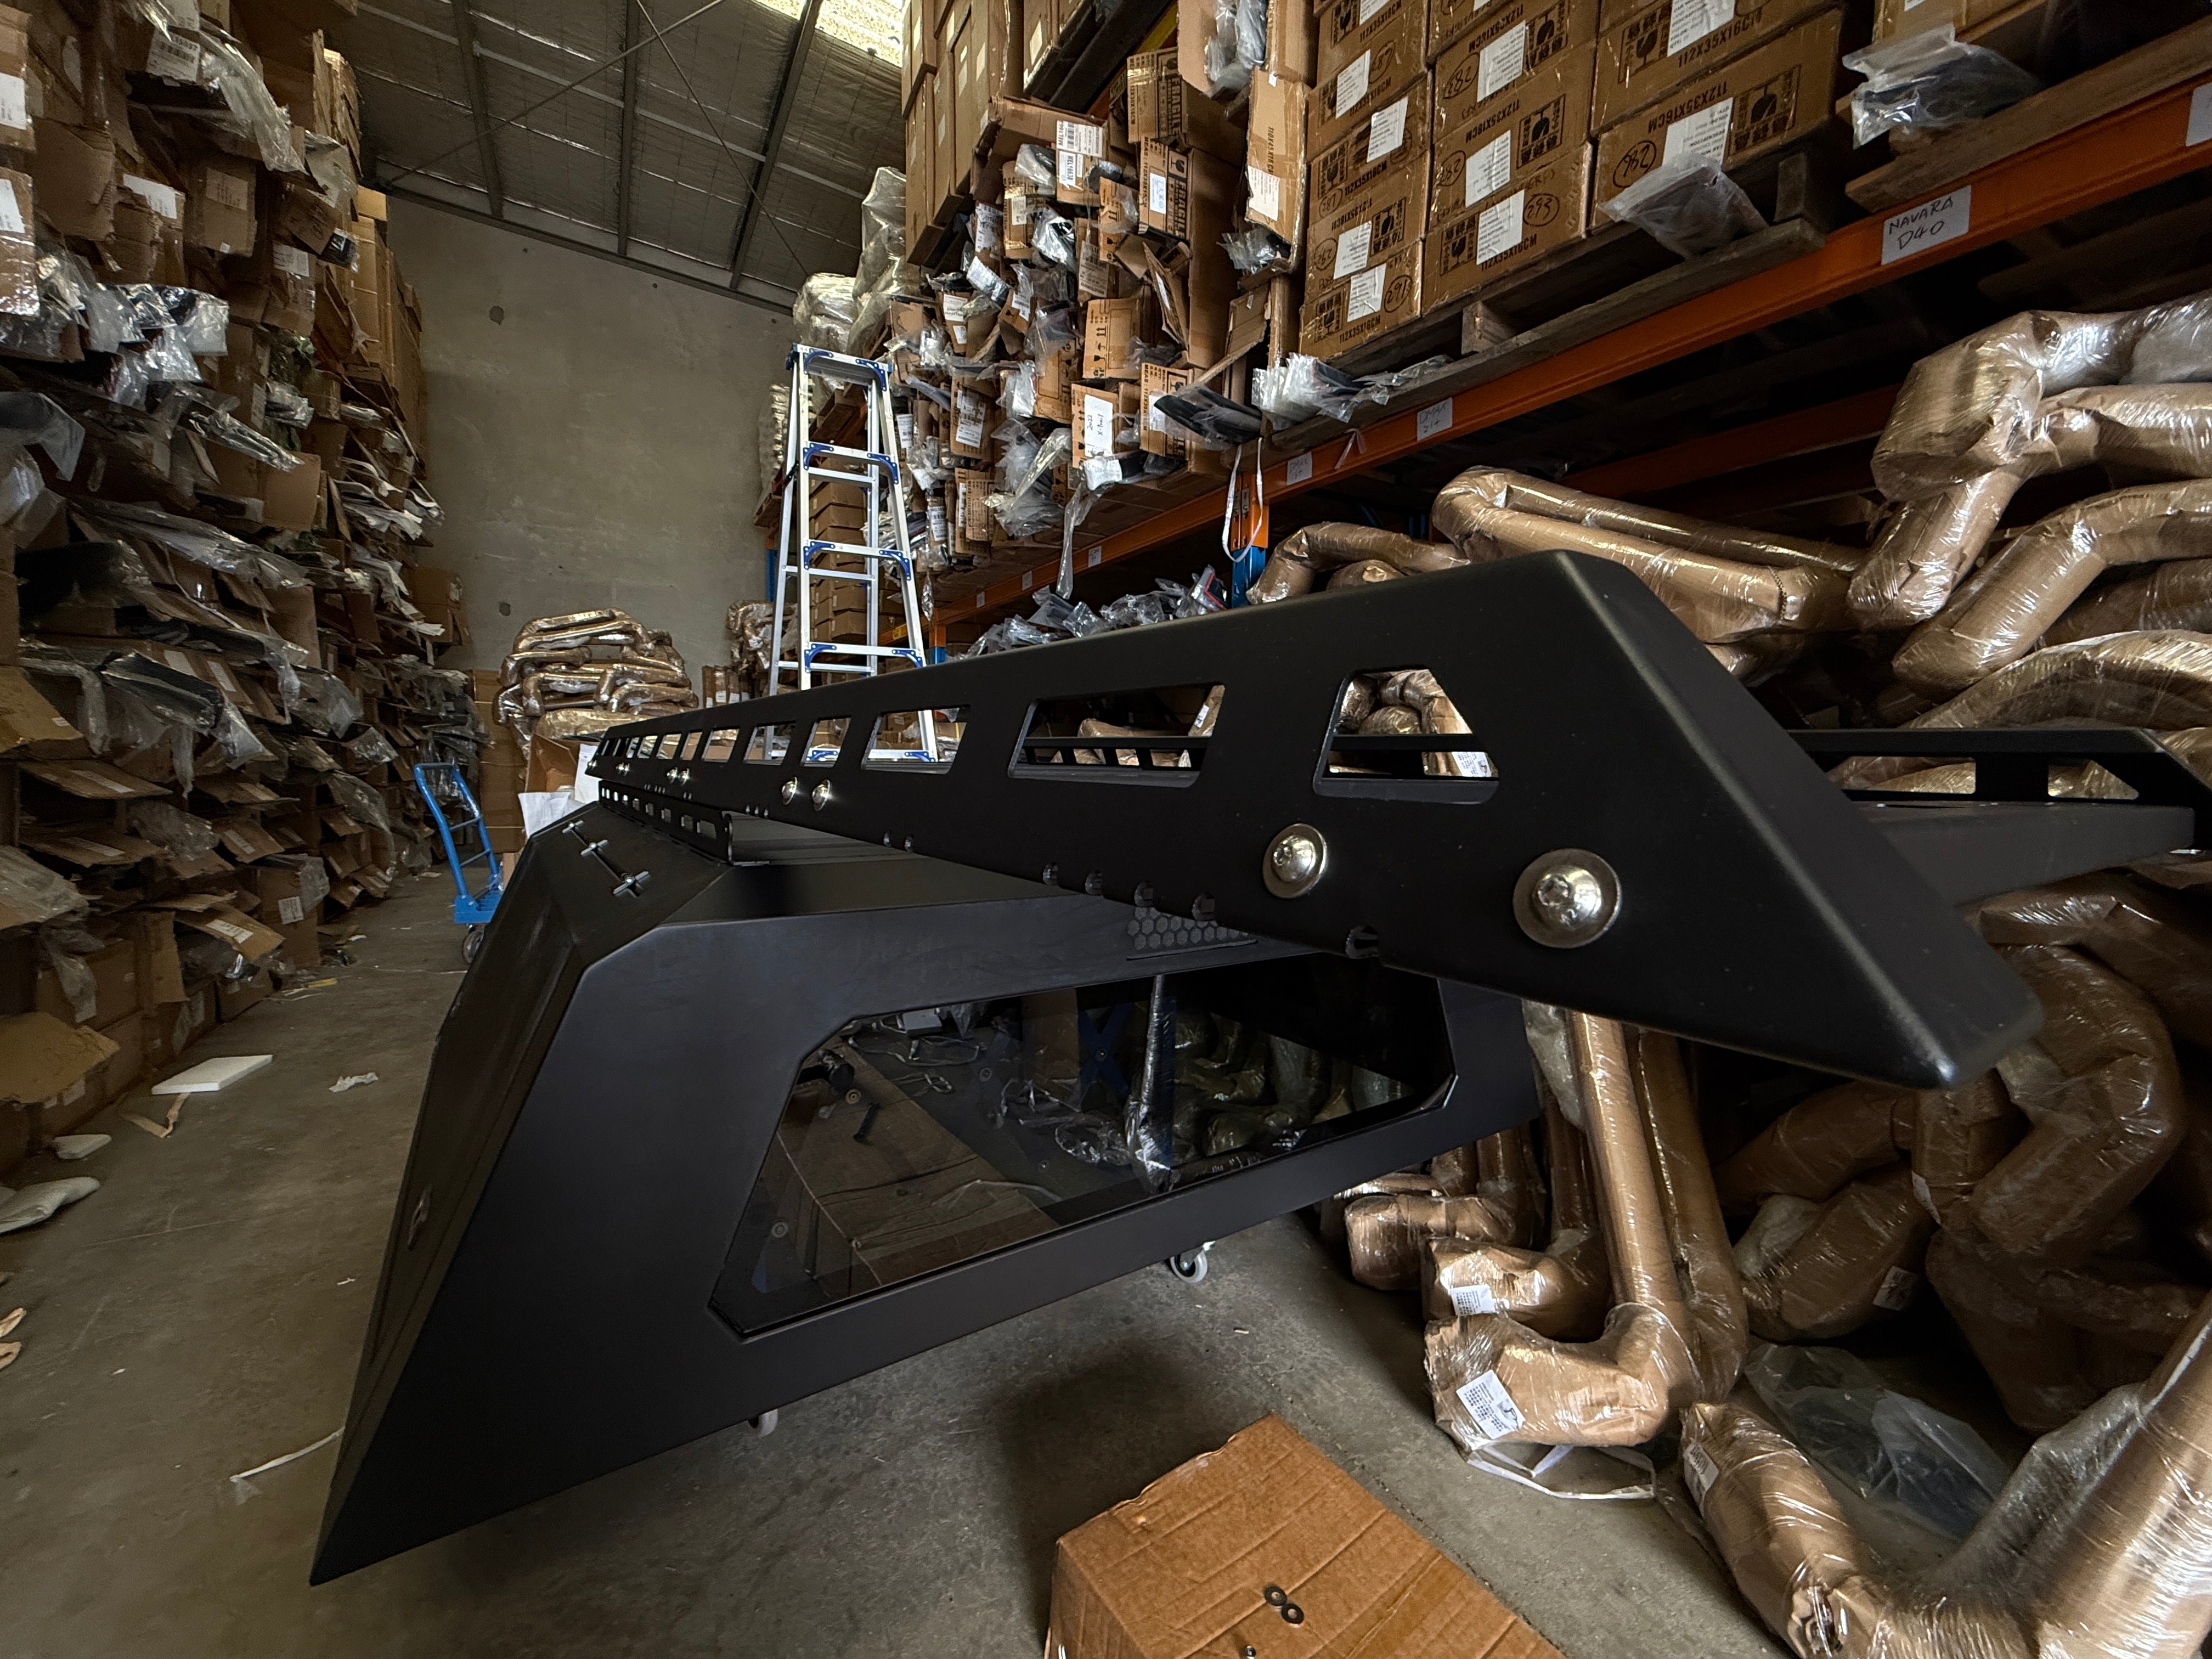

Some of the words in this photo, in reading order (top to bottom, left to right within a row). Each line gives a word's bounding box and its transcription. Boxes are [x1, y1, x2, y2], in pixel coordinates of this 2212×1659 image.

[1178, 181, 1186, 238] FRAGILE
[1889, 195, 1954, 235] NAVARA
[1897, 221, 1944, 250] D40
